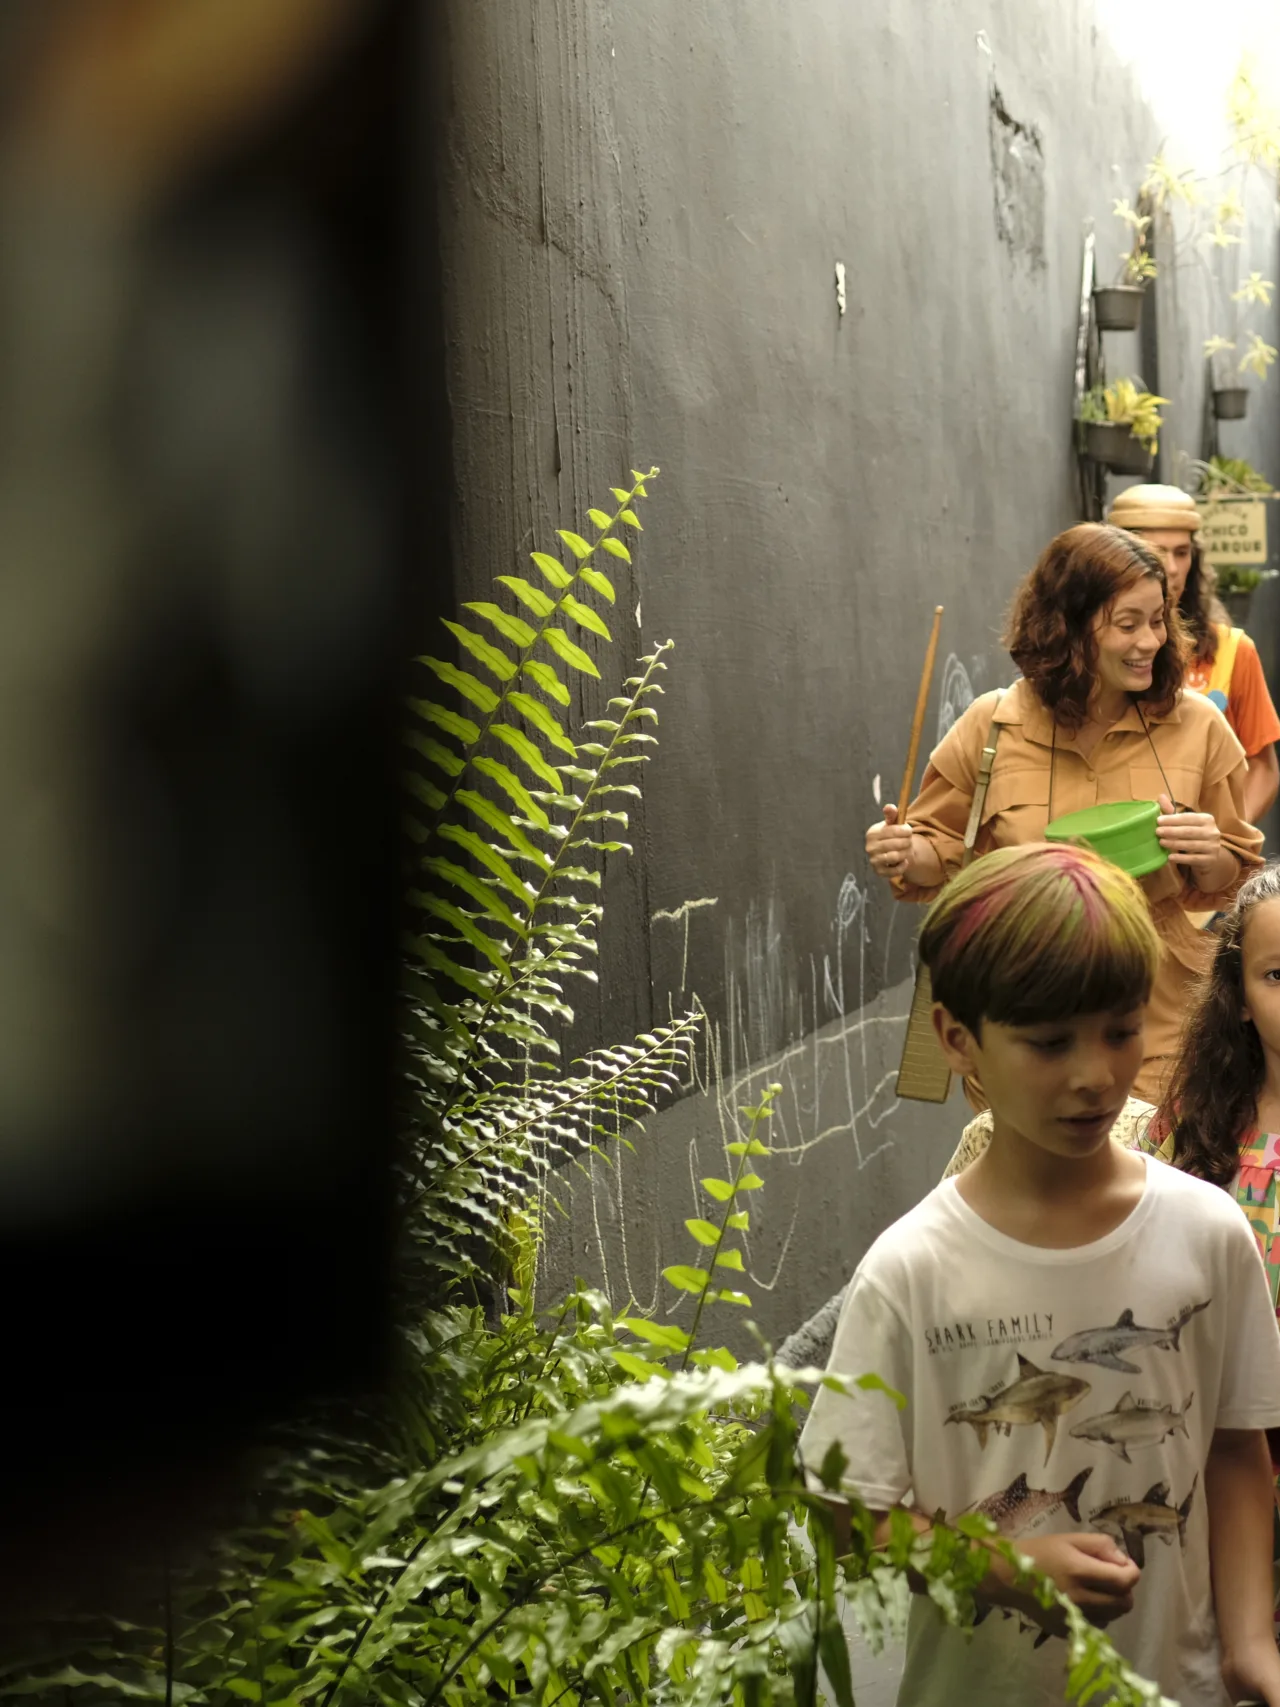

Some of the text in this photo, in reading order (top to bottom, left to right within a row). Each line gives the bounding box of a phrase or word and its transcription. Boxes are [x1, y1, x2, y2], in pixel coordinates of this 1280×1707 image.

[1202, 523, 1249, 538] CHICO
[1205, 540, 1262, 555] ARQUE
[924, 1322, 976, 1348] SHARK
[986, 1312, 1053, 1338] FAMILY
